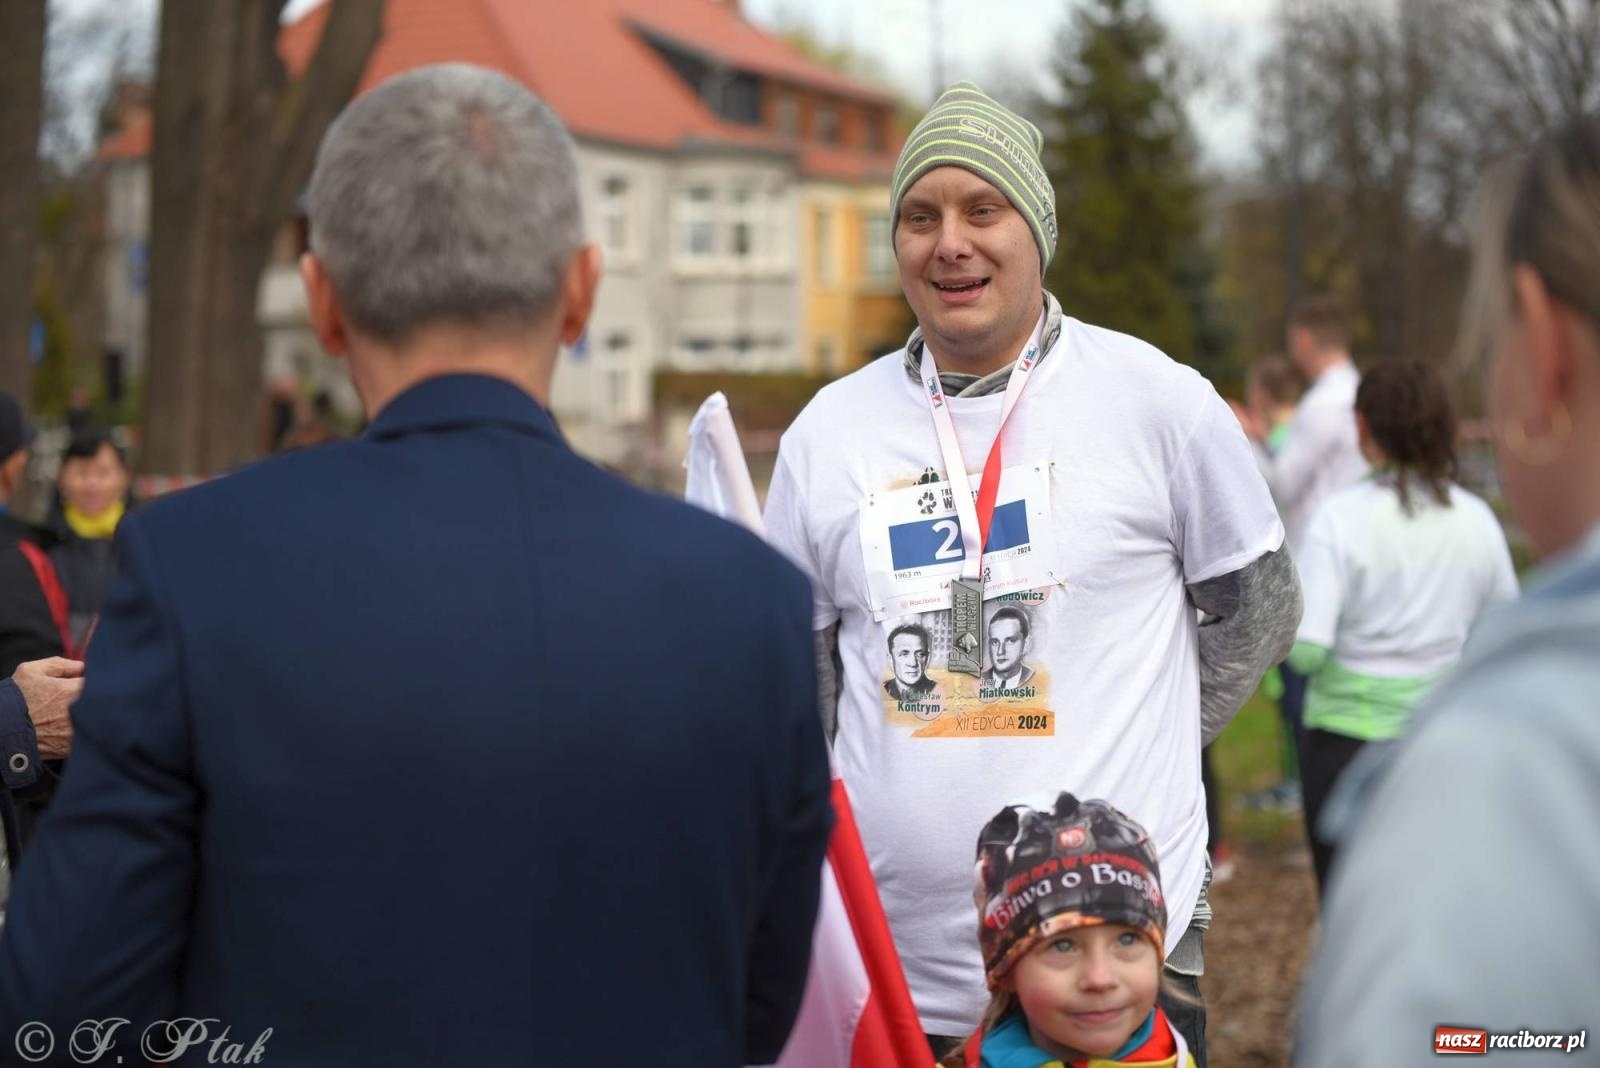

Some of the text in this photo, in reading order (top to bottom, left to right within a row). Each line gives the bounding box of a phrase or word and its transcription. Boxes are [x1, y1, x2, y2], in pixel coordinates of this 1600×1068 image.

[894, 571, 912, 580] 1963
[979, 686, 1036, 699] Miatkowski
[897, 701, 941, 715] Kontrym
[973, 716, 1015, 731] EDYCJA
[1018, 715, 1047, 730] 2024
[1061, 871, 1082, 888] o
